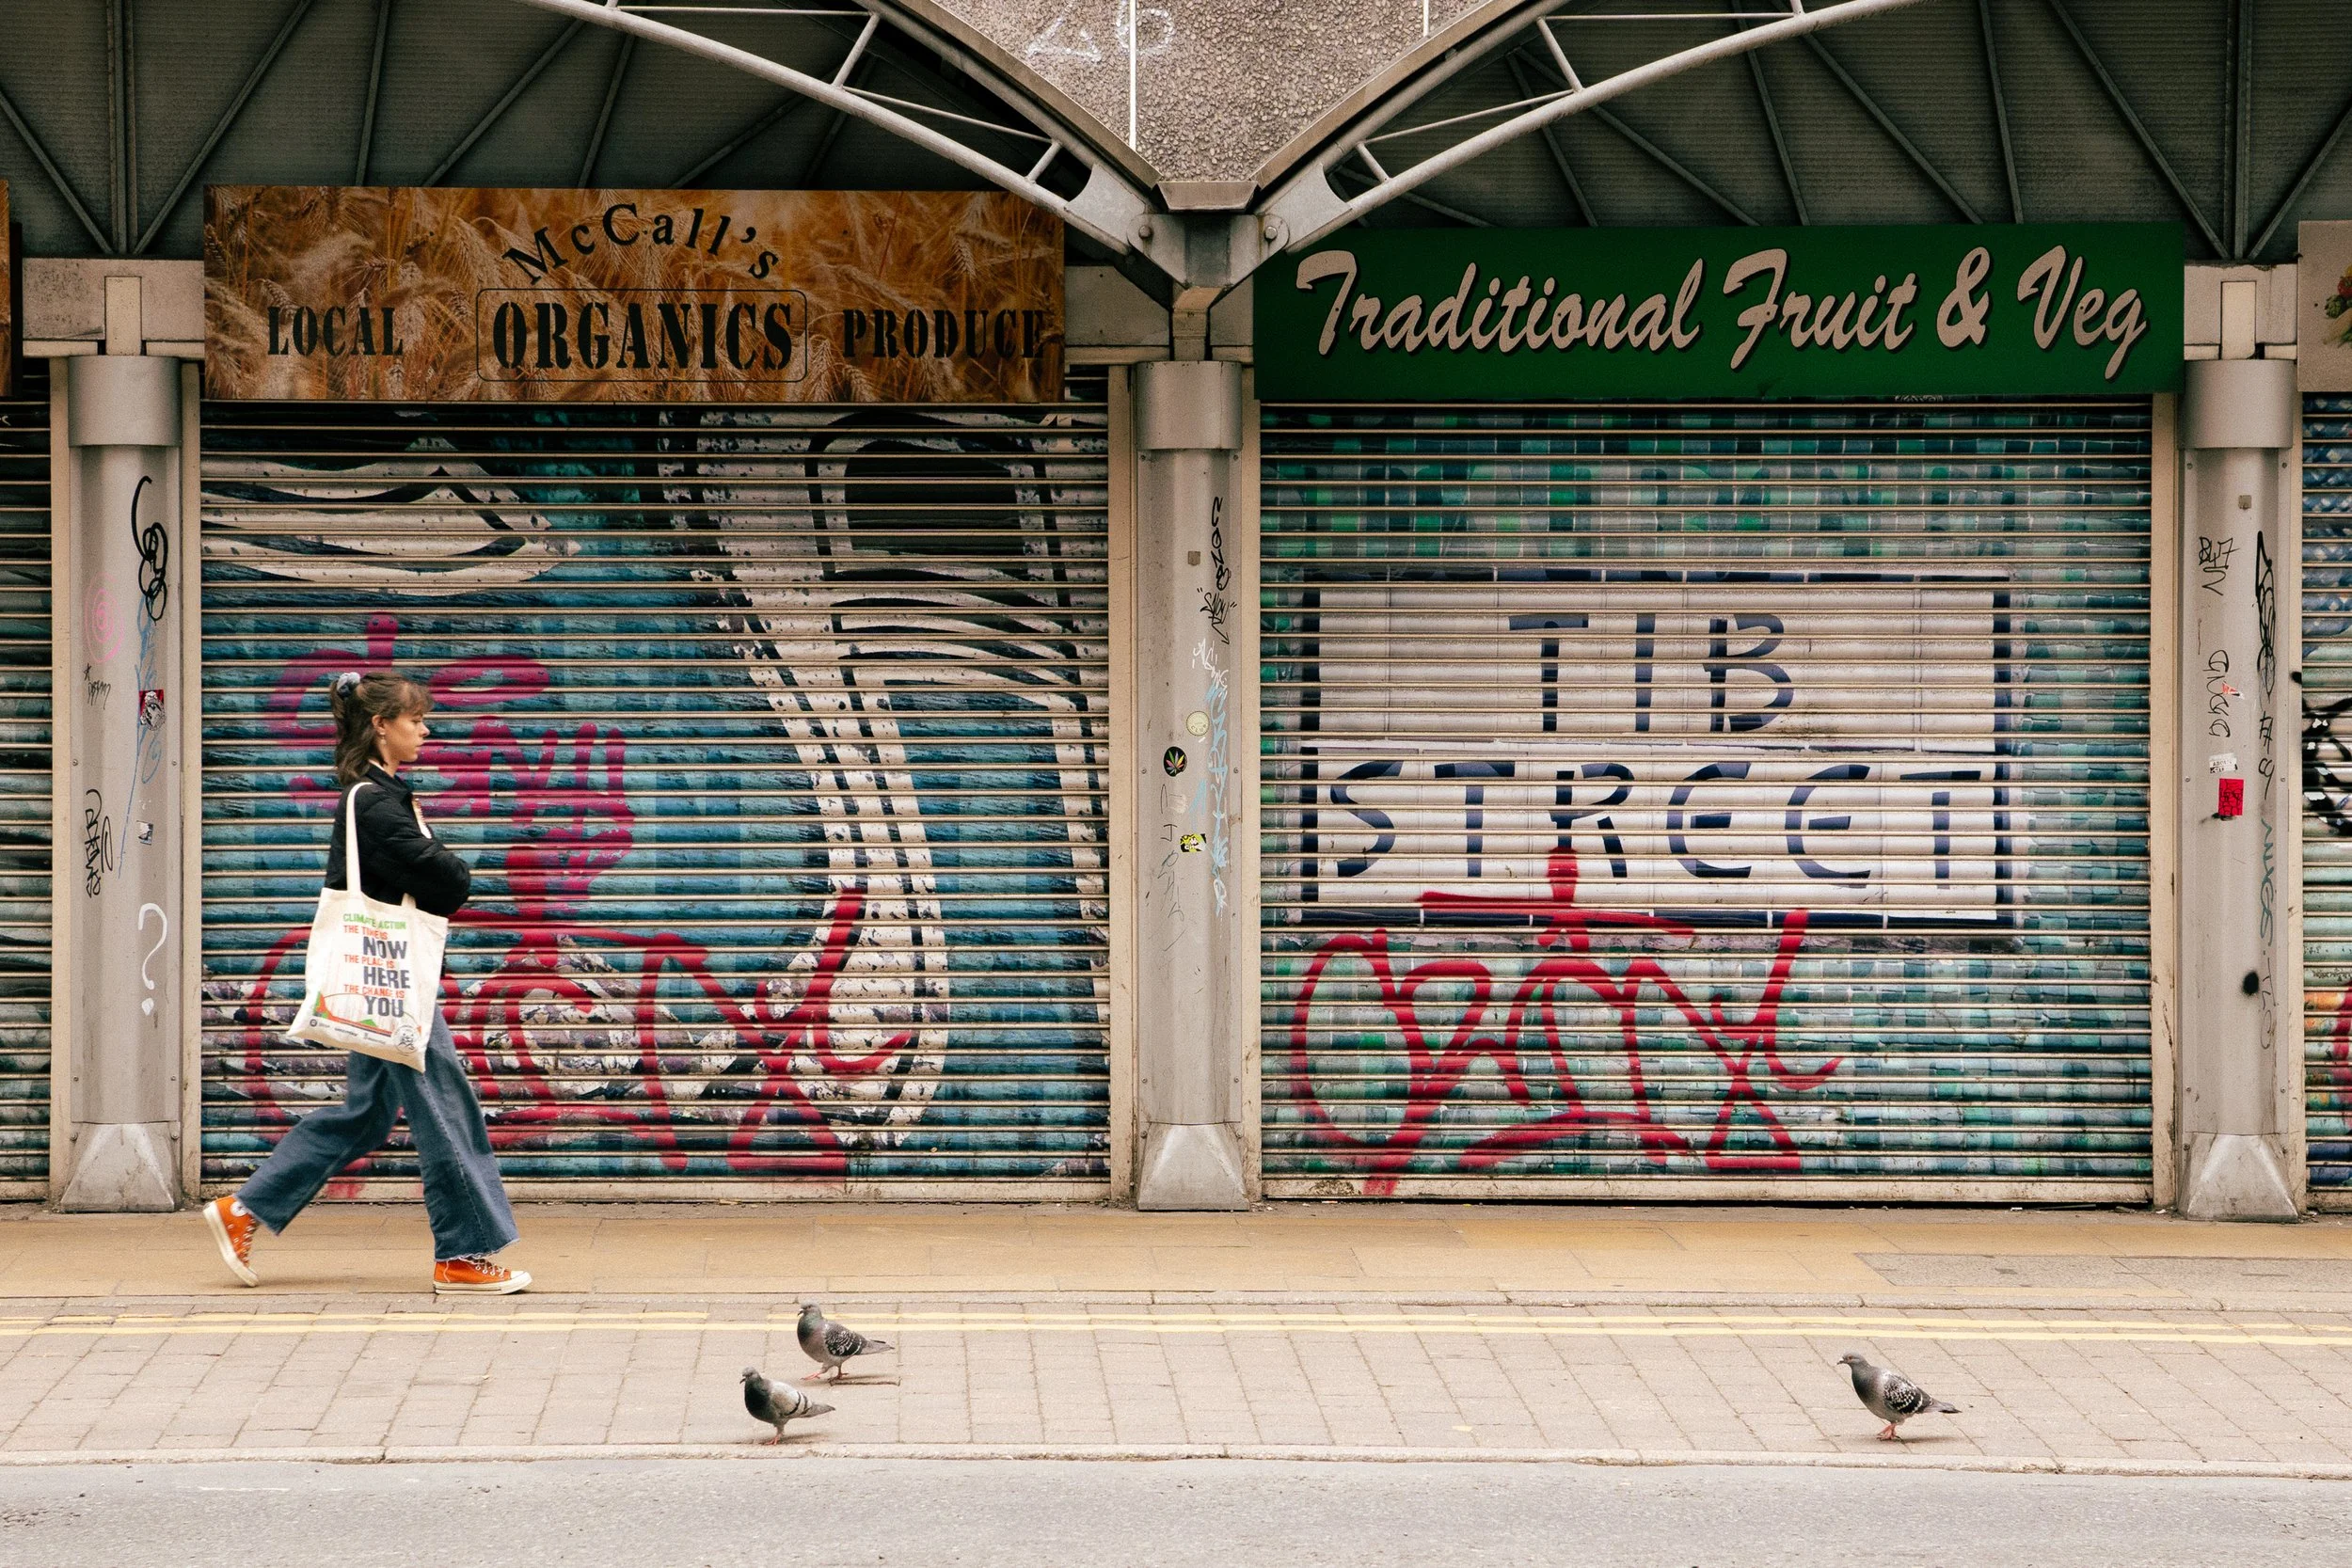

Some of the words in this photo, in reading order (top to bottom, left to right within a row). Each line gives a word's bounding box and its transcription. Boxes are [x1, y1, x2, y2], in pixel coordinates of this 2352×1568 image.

[502, 202, 779, 284] McCall's
[1295, 247, 1705, 357] Traditional
[1723, 246, 1917, 372] Fruit
[1935, 245, 1994, 350] &
[2017, 244, 2152, 382] Veg
[267, 305, 405, 356] LOCAL
[492, 301, 793, 371] ORGANICS
[843, 309, 1045, 359] PRODUCE
[1509, 612, 1794, 733] TIB
[1329, 760, 1982, 890] STREET
[343, 925, 359, 934] THE
[363, 936, 407, 959] NOW
[343, 954, 359, 963] THE
[387, 959, 395, 969] IS
[364, 966, 411, 990] HERE
[343, 984, 359, 993] THE
[395, 990, 405, 999] IS
[364, 995, 405, 1018] YOU
